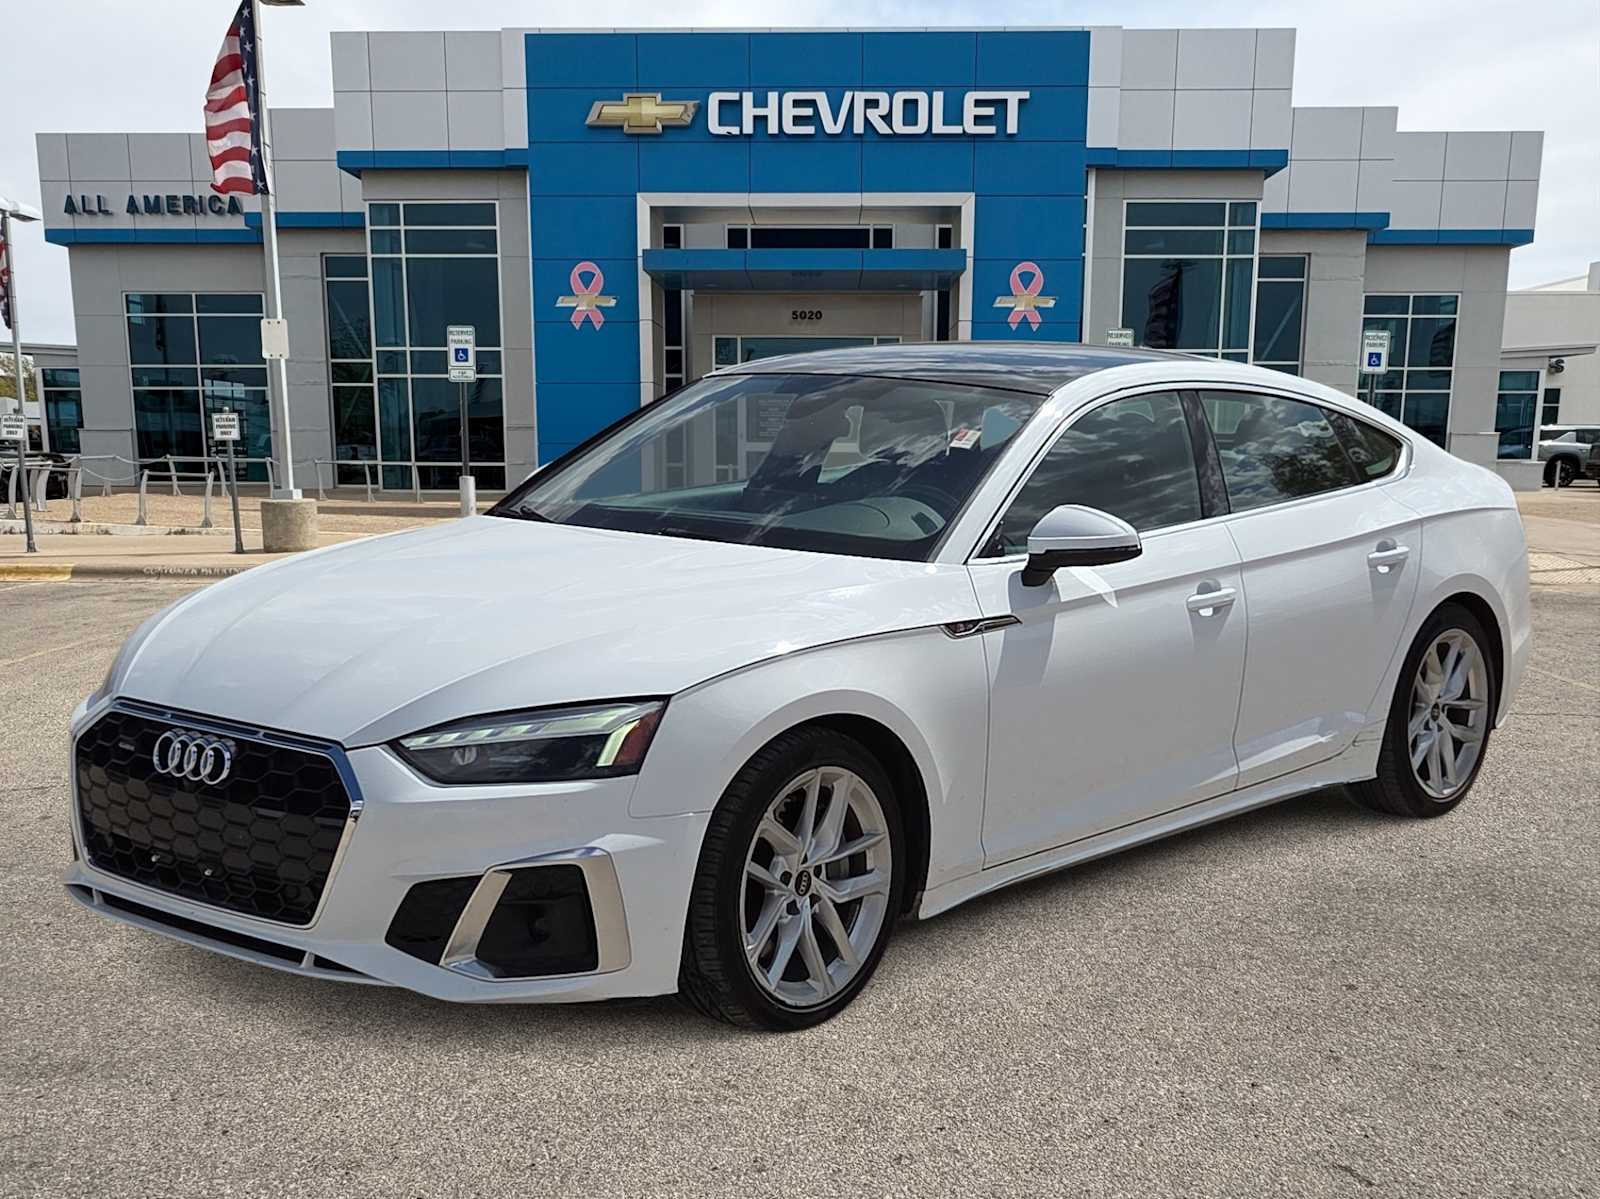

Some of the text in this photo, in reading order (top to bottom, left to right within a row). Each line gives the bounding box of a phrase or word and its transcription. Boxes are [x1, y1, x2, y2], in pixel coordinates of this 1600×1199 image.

[707, 90, 1030, 136] CHEVROLET
[64, 195, 243, 216] ALL AMERICA
[791, 310, 823, 320] 5020
[143, 566, 197, 576] CUSTOMER
